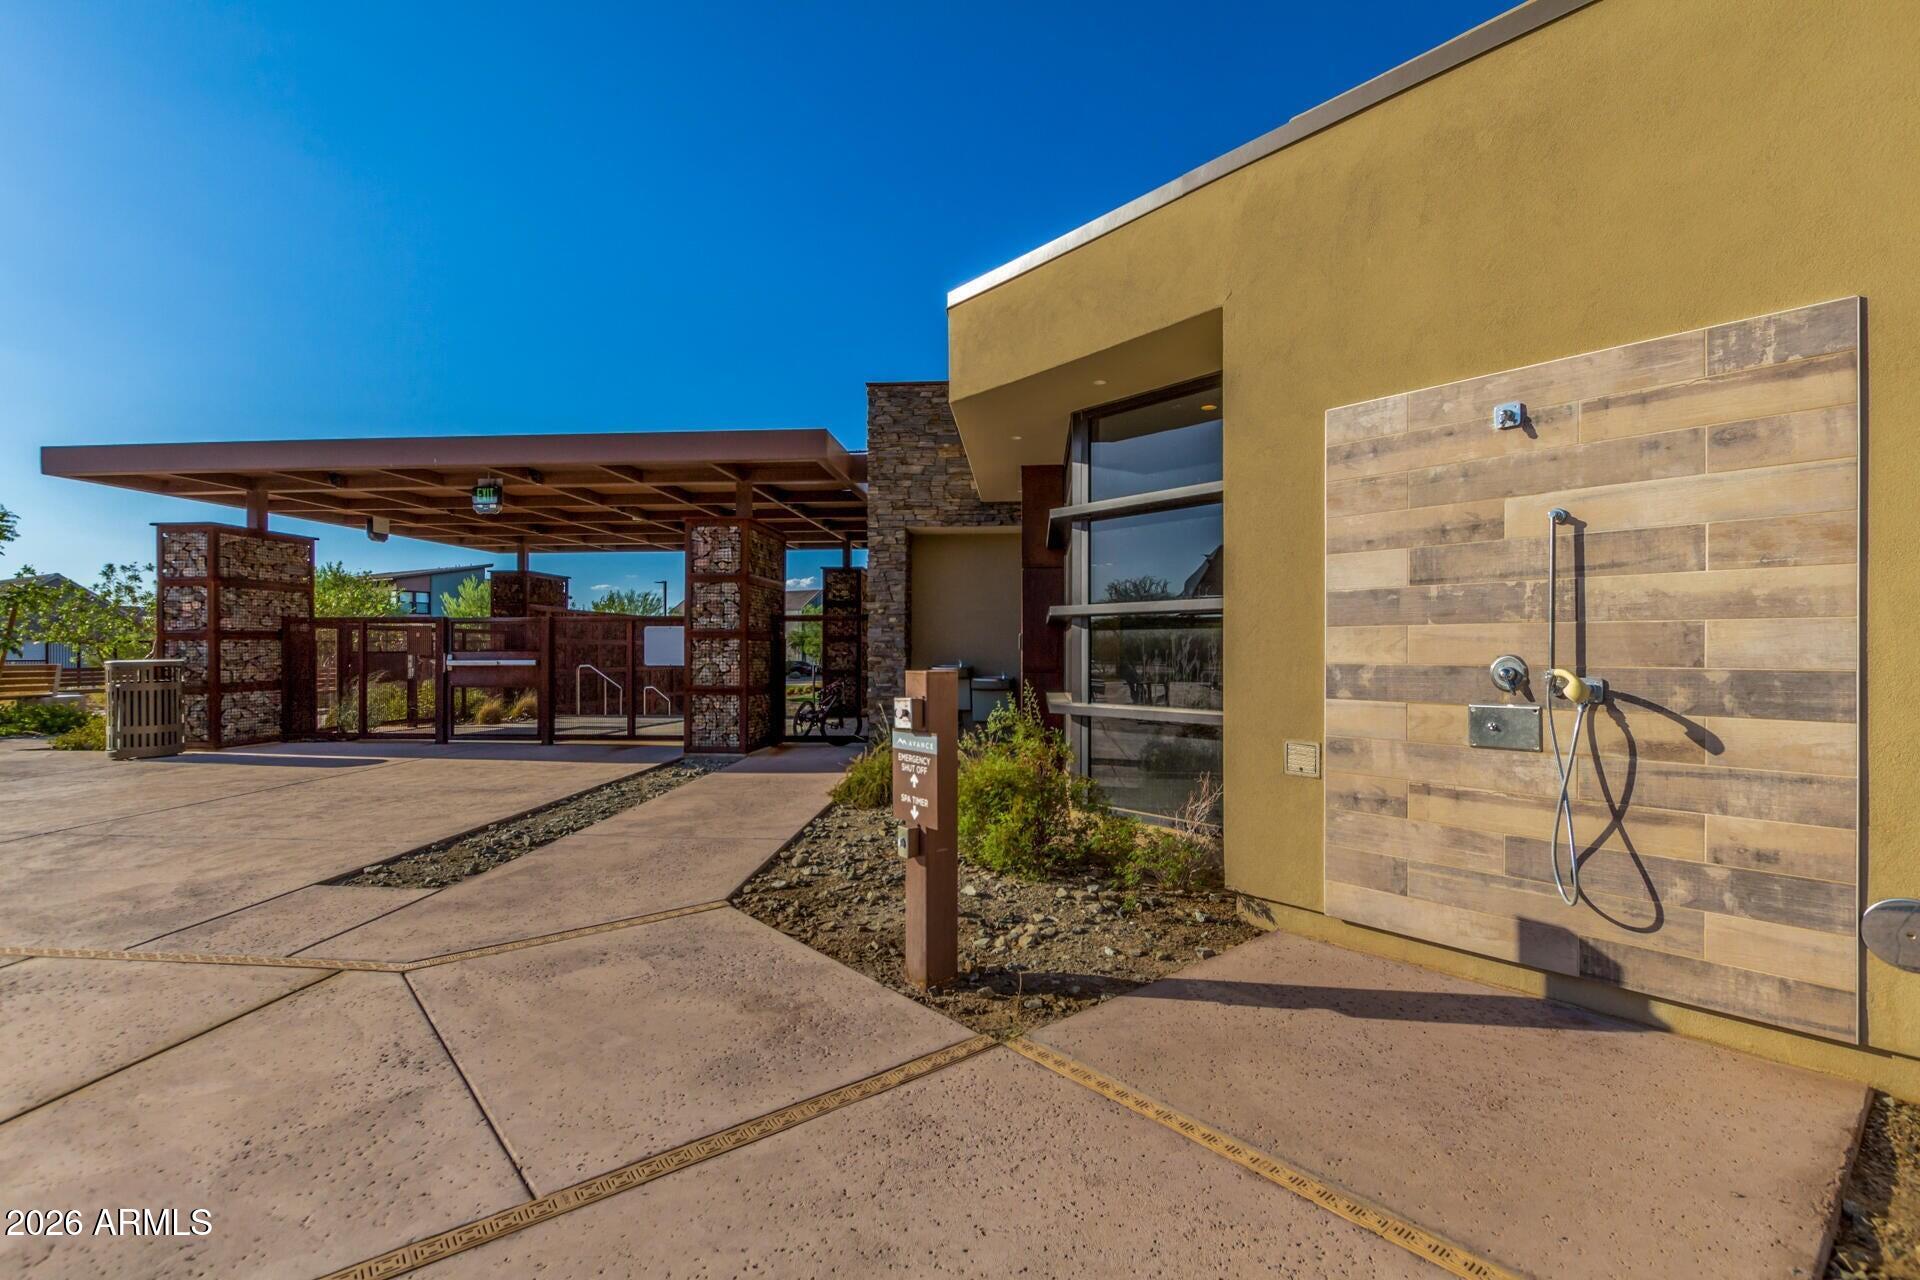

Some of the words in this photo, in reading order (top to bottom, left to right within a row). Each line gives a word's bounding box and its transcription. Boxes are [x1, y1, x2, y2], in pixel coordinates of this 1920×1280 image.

[477, 488, 494, 502] EXIT
[909, 741, 933, 750] AVANCE
[898, 752, 931, 765] EMERGENCY
[901, 763, 915, 772] SHUT
[916, 766, 928, 775] OFF
[901, 794, 911, 803] SPA
[912, 796, 928, 807] TIMER
